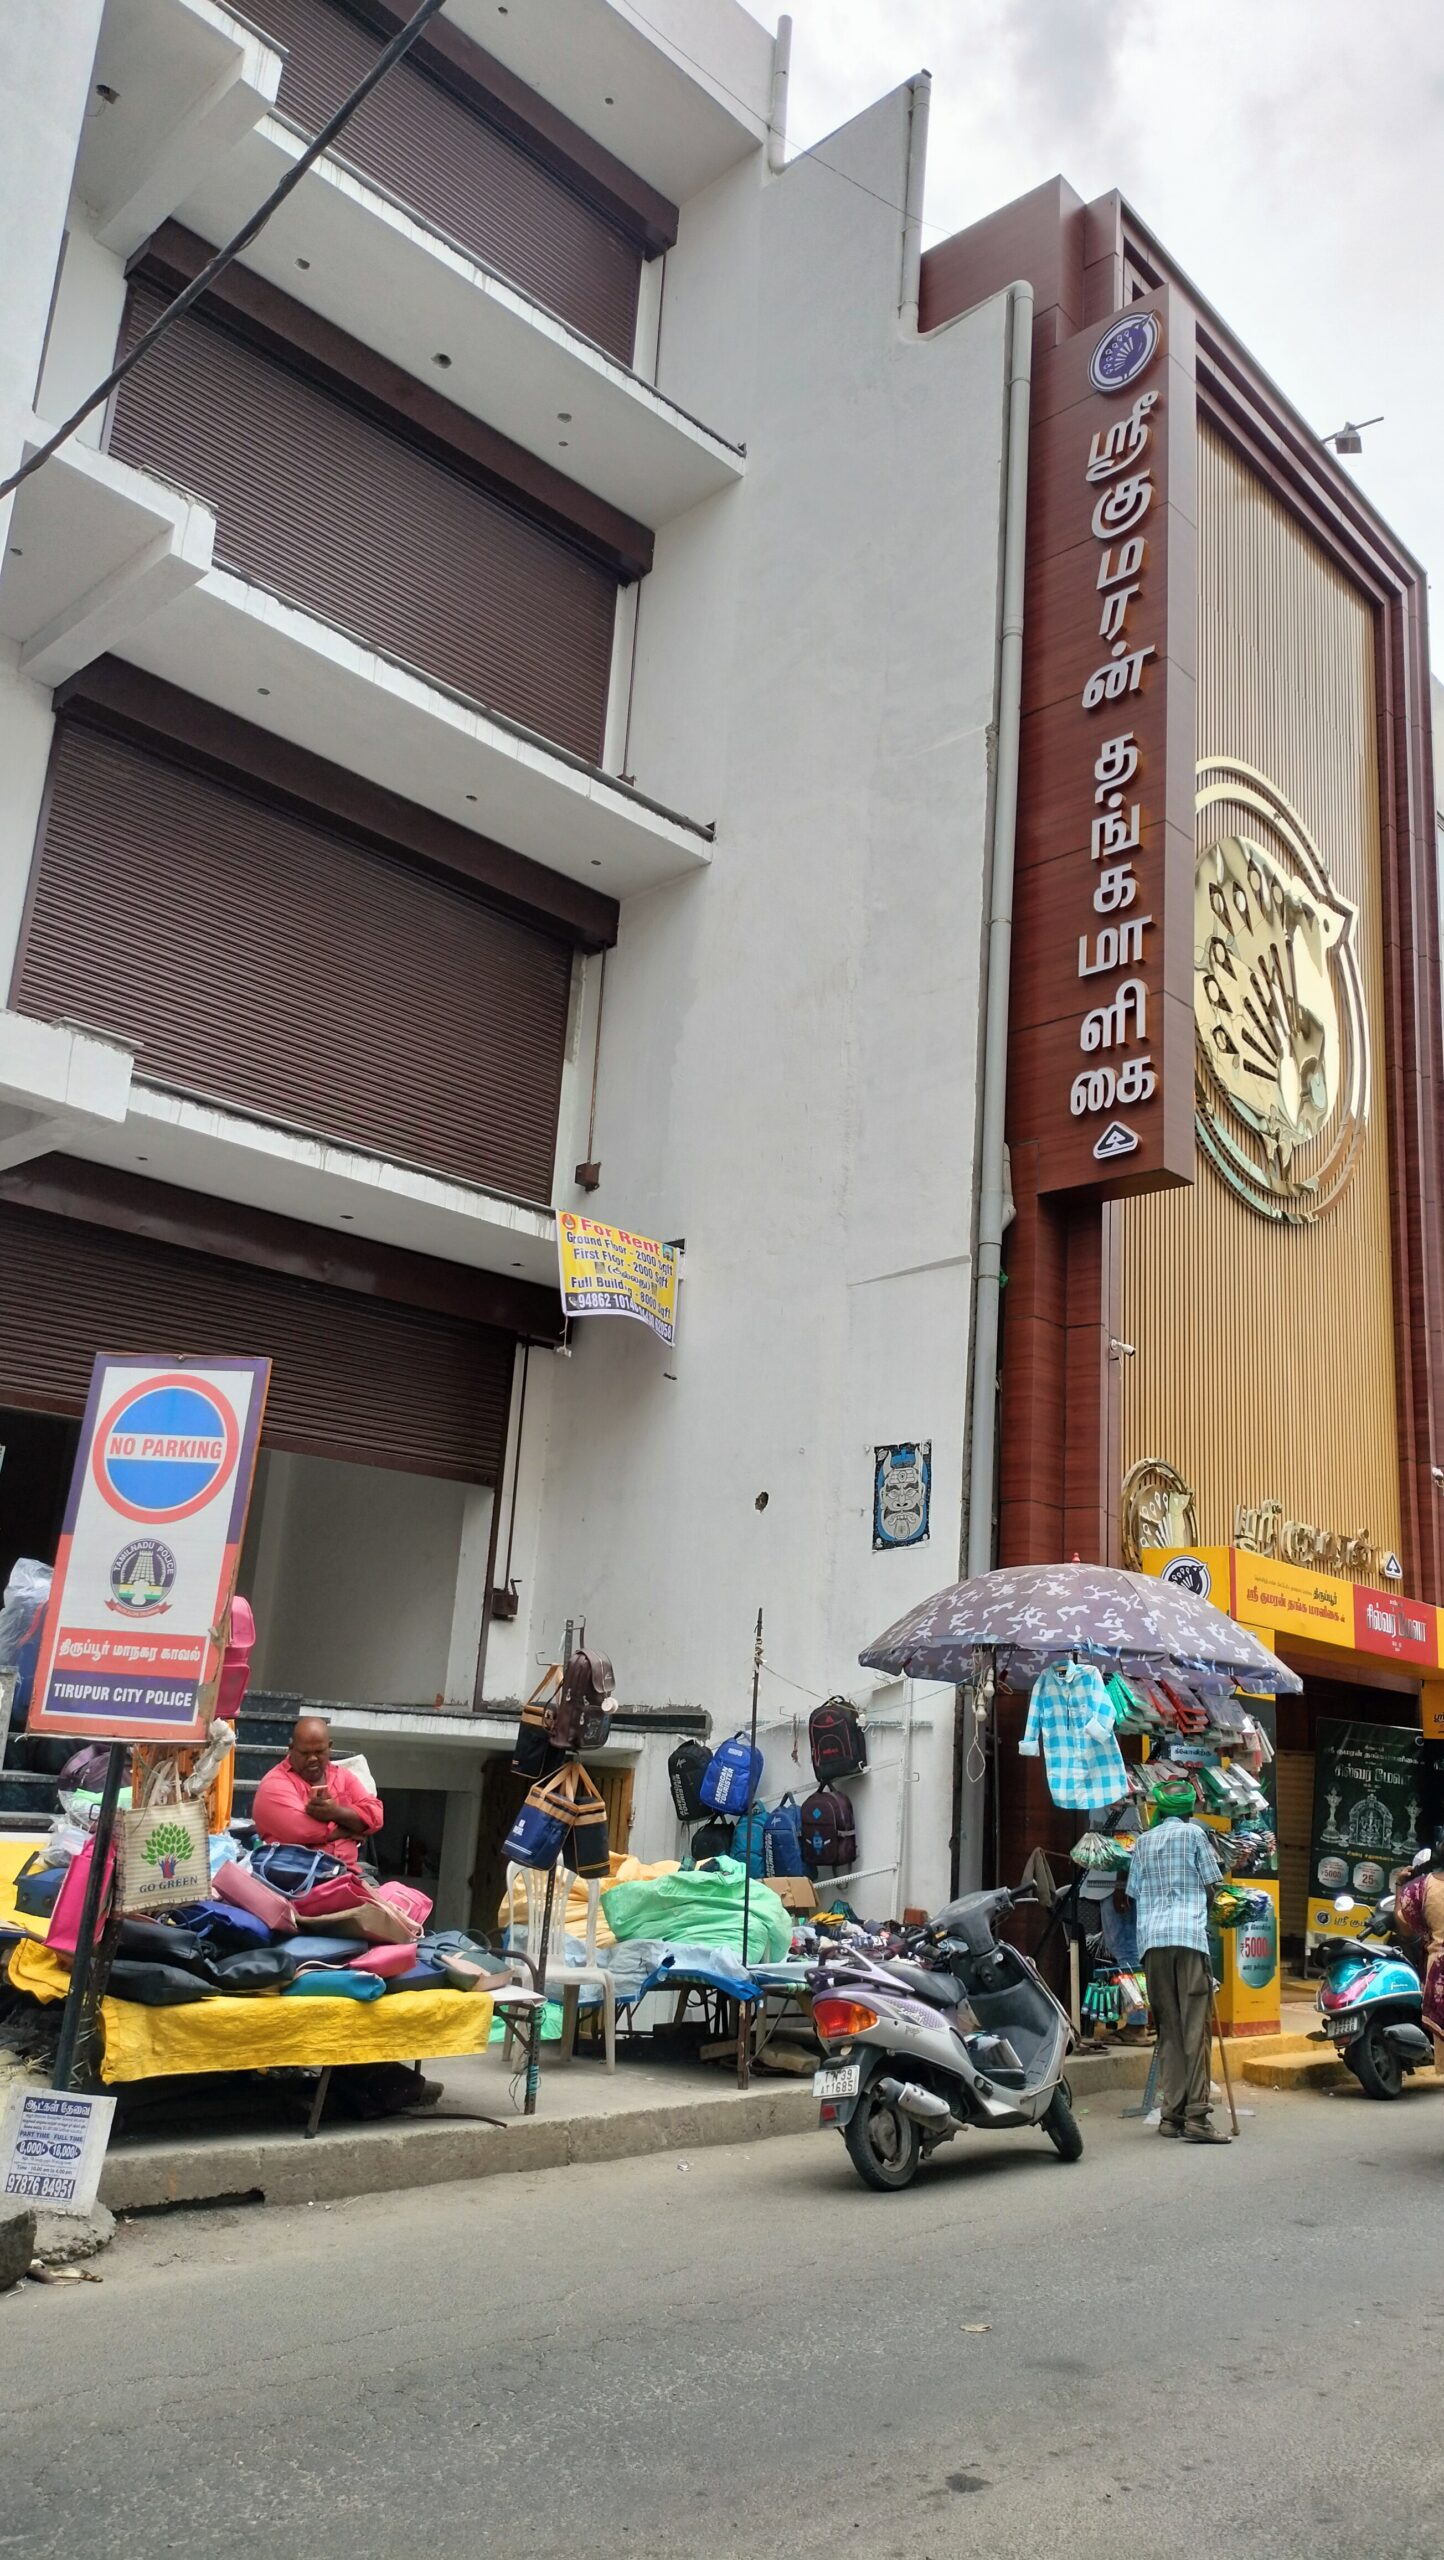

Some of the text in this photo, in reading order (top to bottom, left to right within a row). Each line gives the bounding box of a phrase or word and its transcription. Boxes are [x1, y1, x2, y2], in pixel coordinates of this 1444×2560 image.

[580, 1217, 661, 1256] For Rent
[566, 1231, 602, 1247] Ground
[605, 1239, 627, 1255] Floor
[635, 1250, 657, 1267] 2000
[573, 1248, 599, 1260] First
[602, 1252, 625, 1268] Floor
[633, 1261, 653, 1279] 2000
[570, 1275, 592, 1288] Full
[578, 1293, 611, 1308] 94862
[109, 1436, 222, 1460] NO PARKING
[113, 1541, 174, 1575] TAMILNADU POLICE
[59, 1638, 201, 1661] திருப்பூர் மாநகர காவல்
[54, 1683, 193, 1707] TIRUPUR CITY POLICE
[715, 1766, 729, 1803] AMERICAN
[720, 1767, 734, 1805] TOURISTER
[139, 1876, 198, 1893] GO GREEN
[1362, 1874, 1374, 1885] 25
[25, 2099, 91, 2116] ஆட்கள் தேவை
[7, 2174, 74, 2199] 97876 84951
